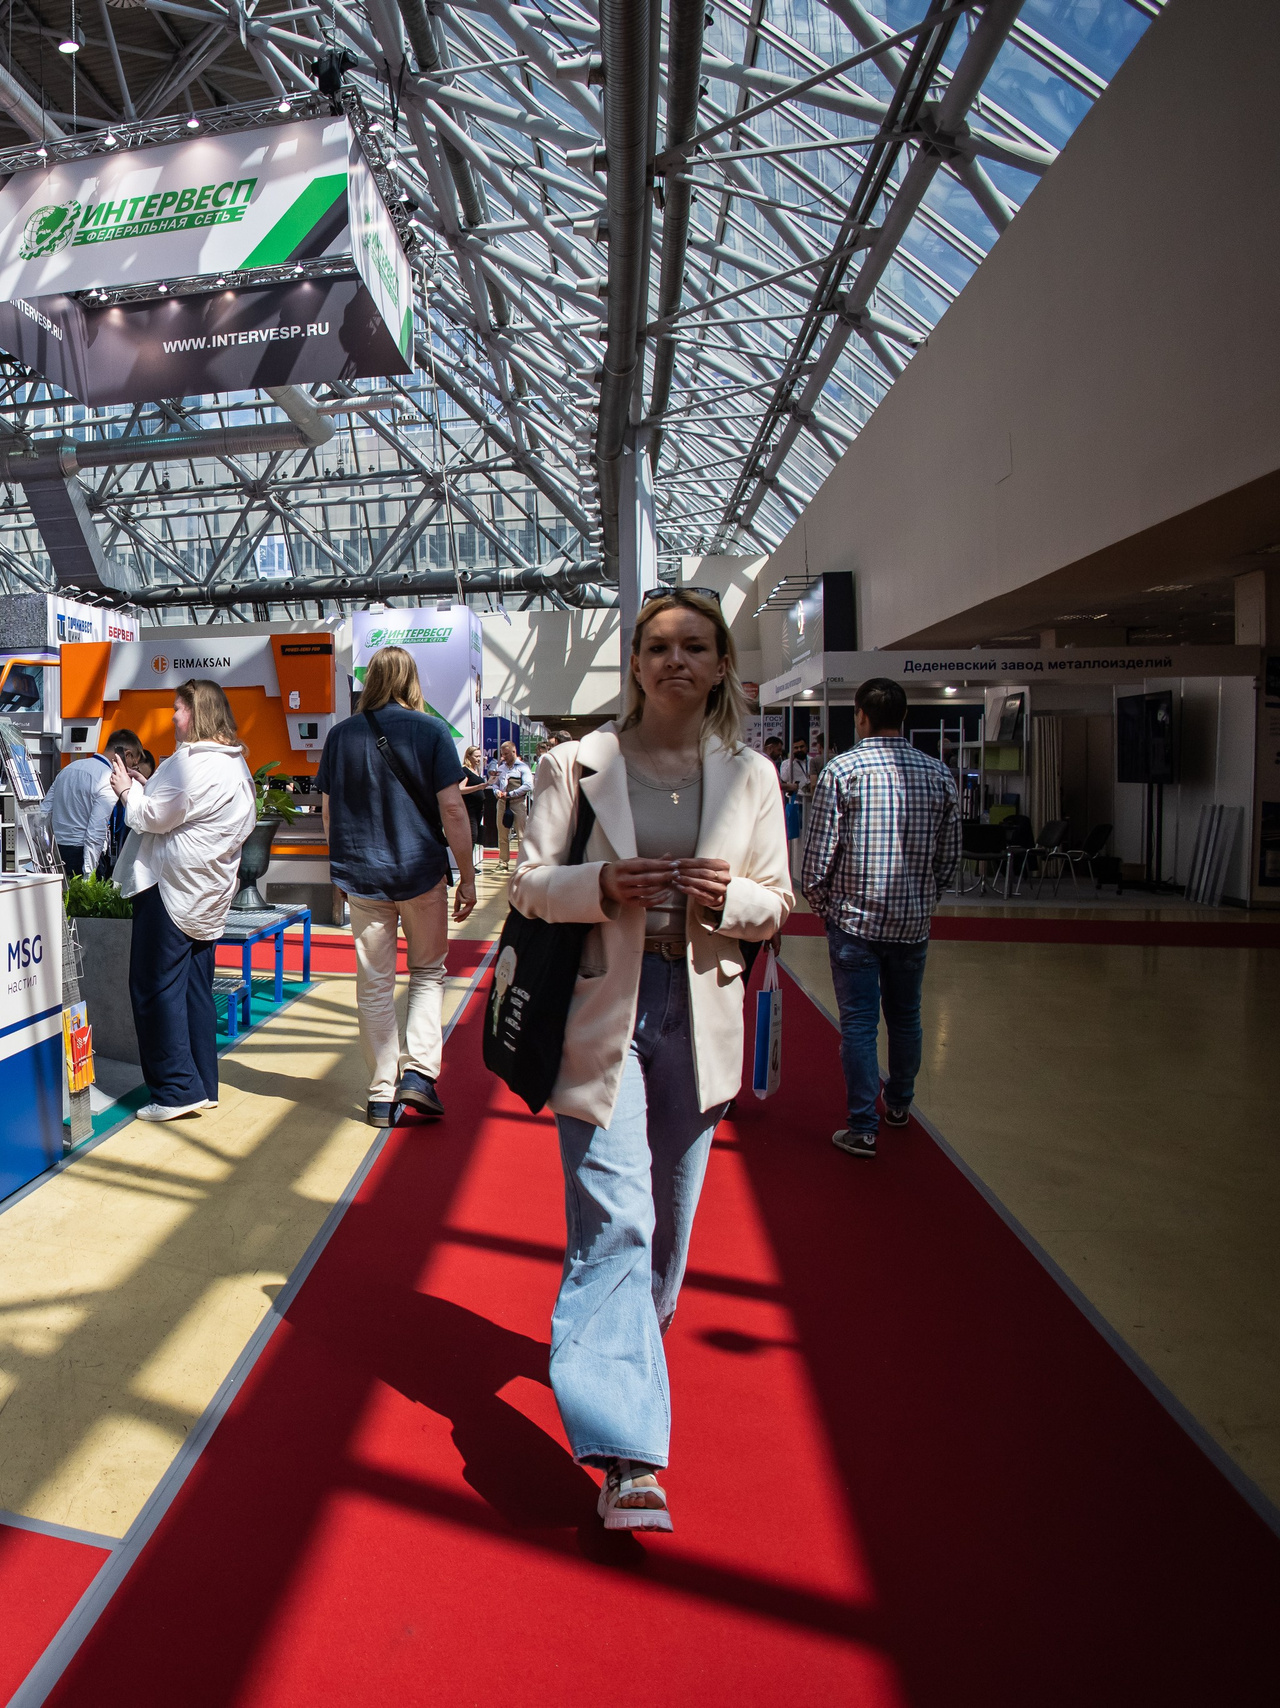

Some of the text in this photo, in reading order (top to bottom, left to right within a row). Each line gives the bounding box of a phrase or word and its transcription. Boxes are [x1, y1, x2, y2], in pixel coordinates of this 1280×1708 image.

[79, 178, 258, 229] ИНТЕРВЕСП
[86, 210, 231, 242] ФЕДЕРАЛЬНАЯ СЕТЬ
[163, 322, 330, 353] WWW.INTERVESP.RU
[387, 627, 453, 639] ИНТЕРВЕСП
[173, 656, 231, 669] ERMAKSAN
[904, 656, 1173, 673] Деденевский завод металлоизделий
[7, 934, 43, 972] MSG
[7, 974, 38, 995] настил
